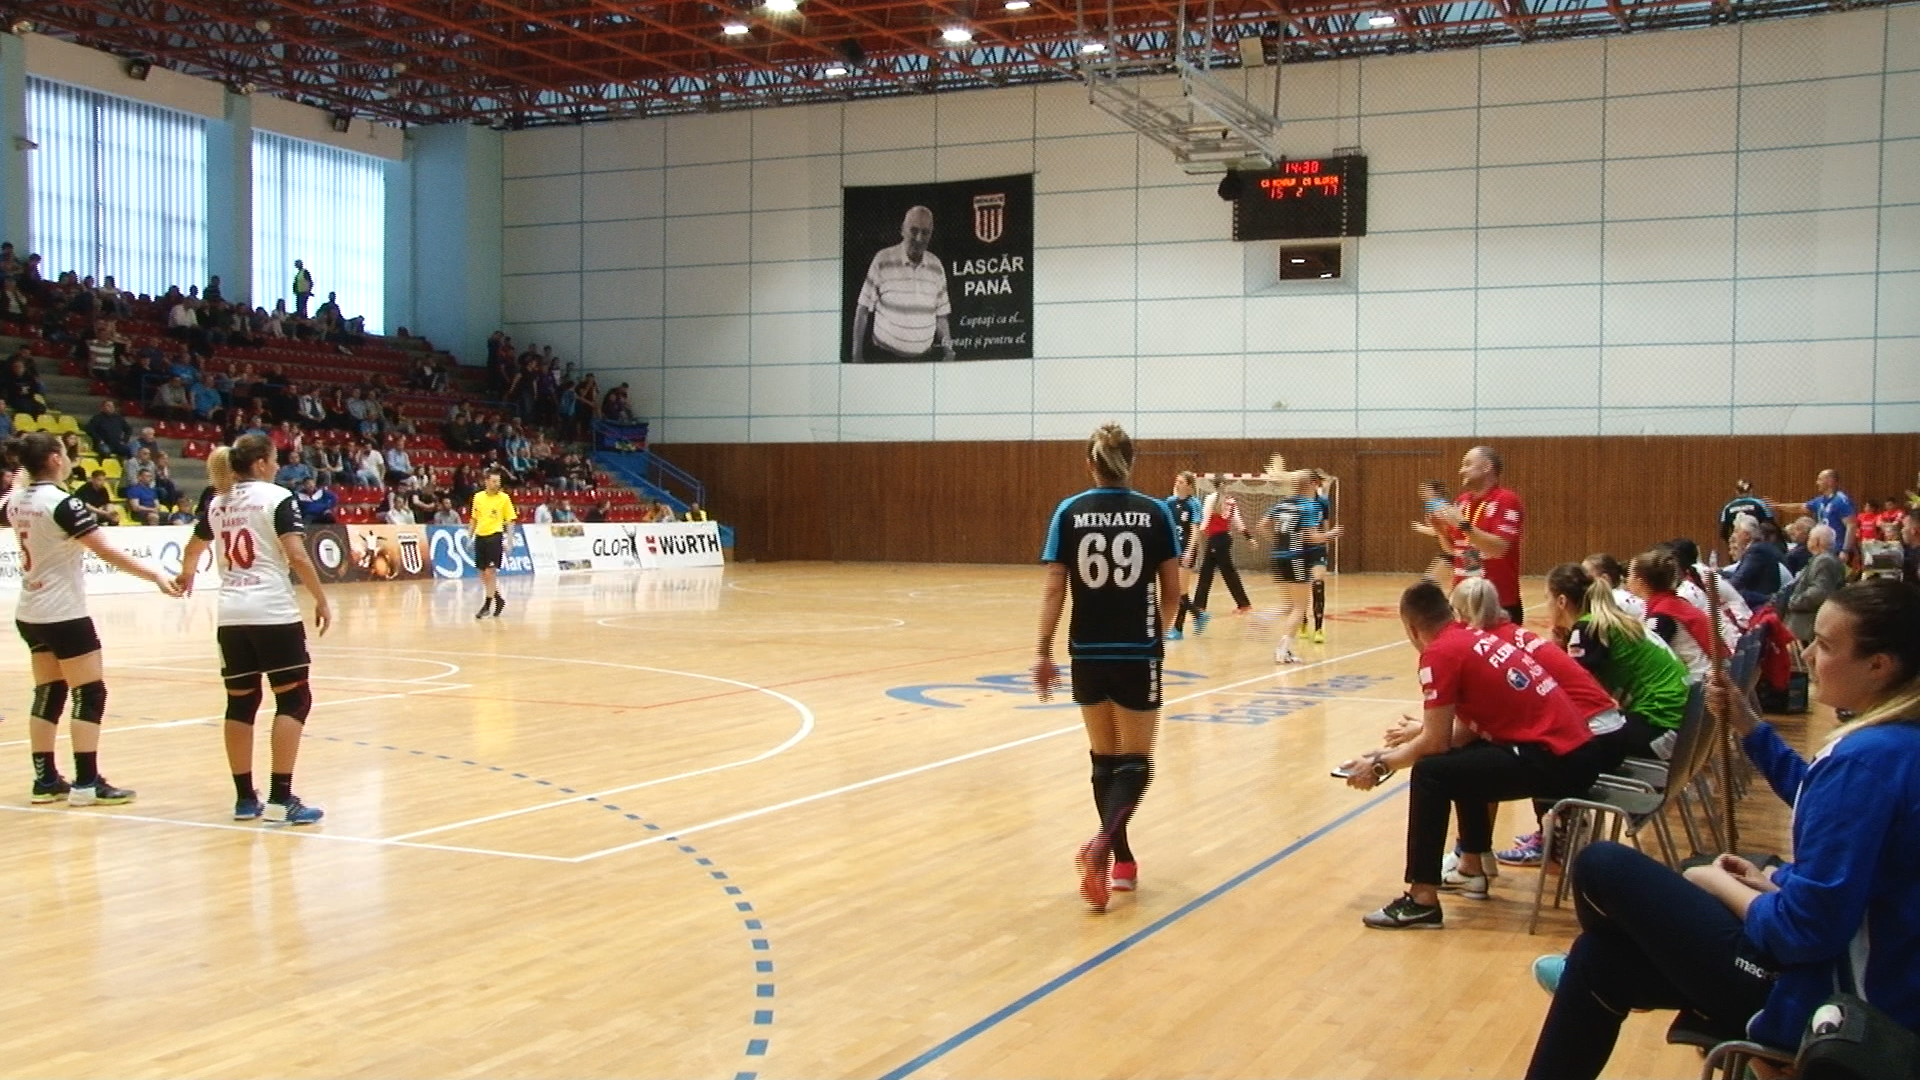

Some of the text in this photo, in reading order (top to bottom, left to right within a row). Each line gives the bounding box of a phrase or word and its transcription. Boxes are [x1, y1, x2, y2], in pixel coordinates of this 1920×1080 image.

[1271, 187, 1284, 199] 15
[953, 254, 1024, 276] LASCĂR
[964, 275, 1012, 297] PANĂ
[1073, 511, 1152, 529] MINAUR
[221, 528, 256, 571] 10
[1077, 530, 1144, 590] 69
